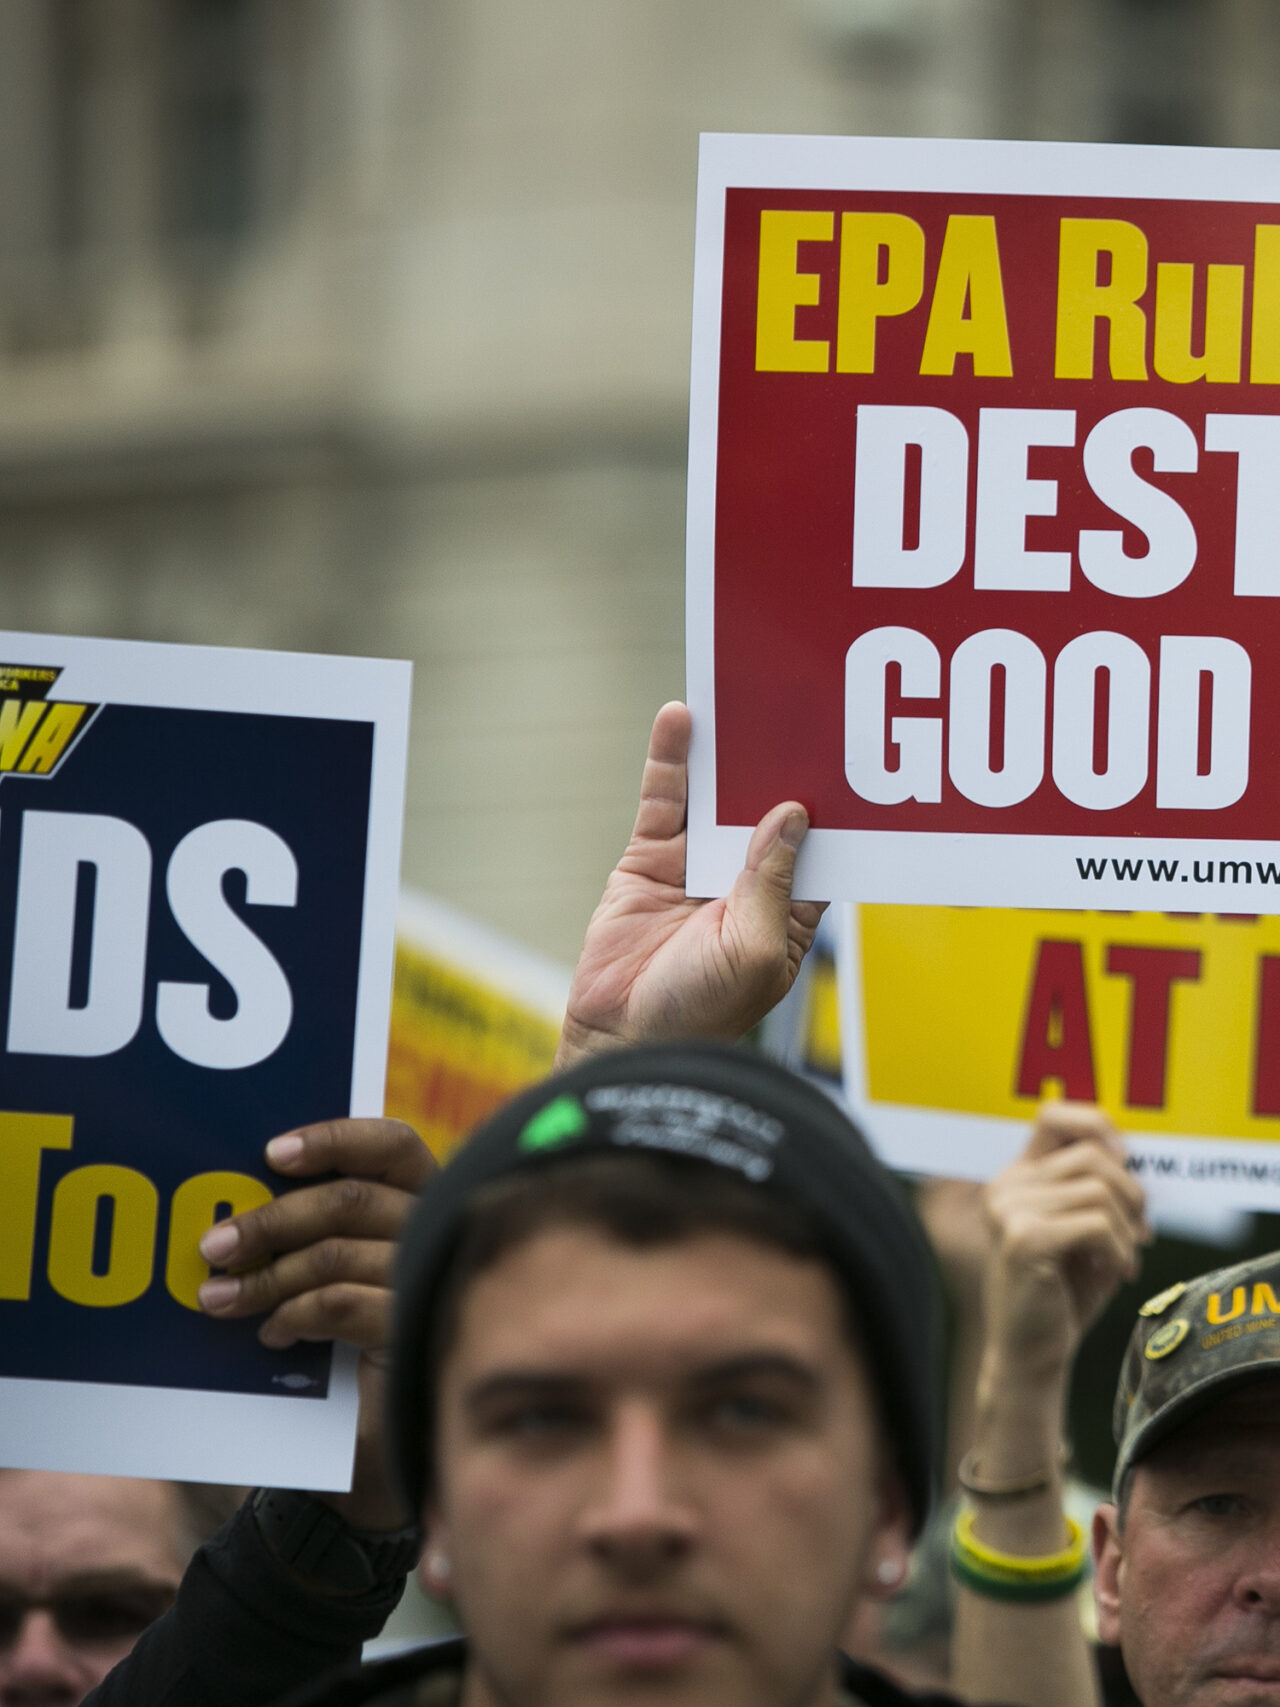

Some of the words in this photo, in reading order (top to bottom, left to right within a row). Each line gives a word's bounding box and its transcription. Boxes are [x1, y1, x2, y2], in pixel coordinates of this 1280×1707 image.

[755, 209, 1013, 378] EPA
[844, 626, 1252, 811] GOOD
[6, 809, 299, 1070] DS
[1014, 936, 1205, 1112] AT
